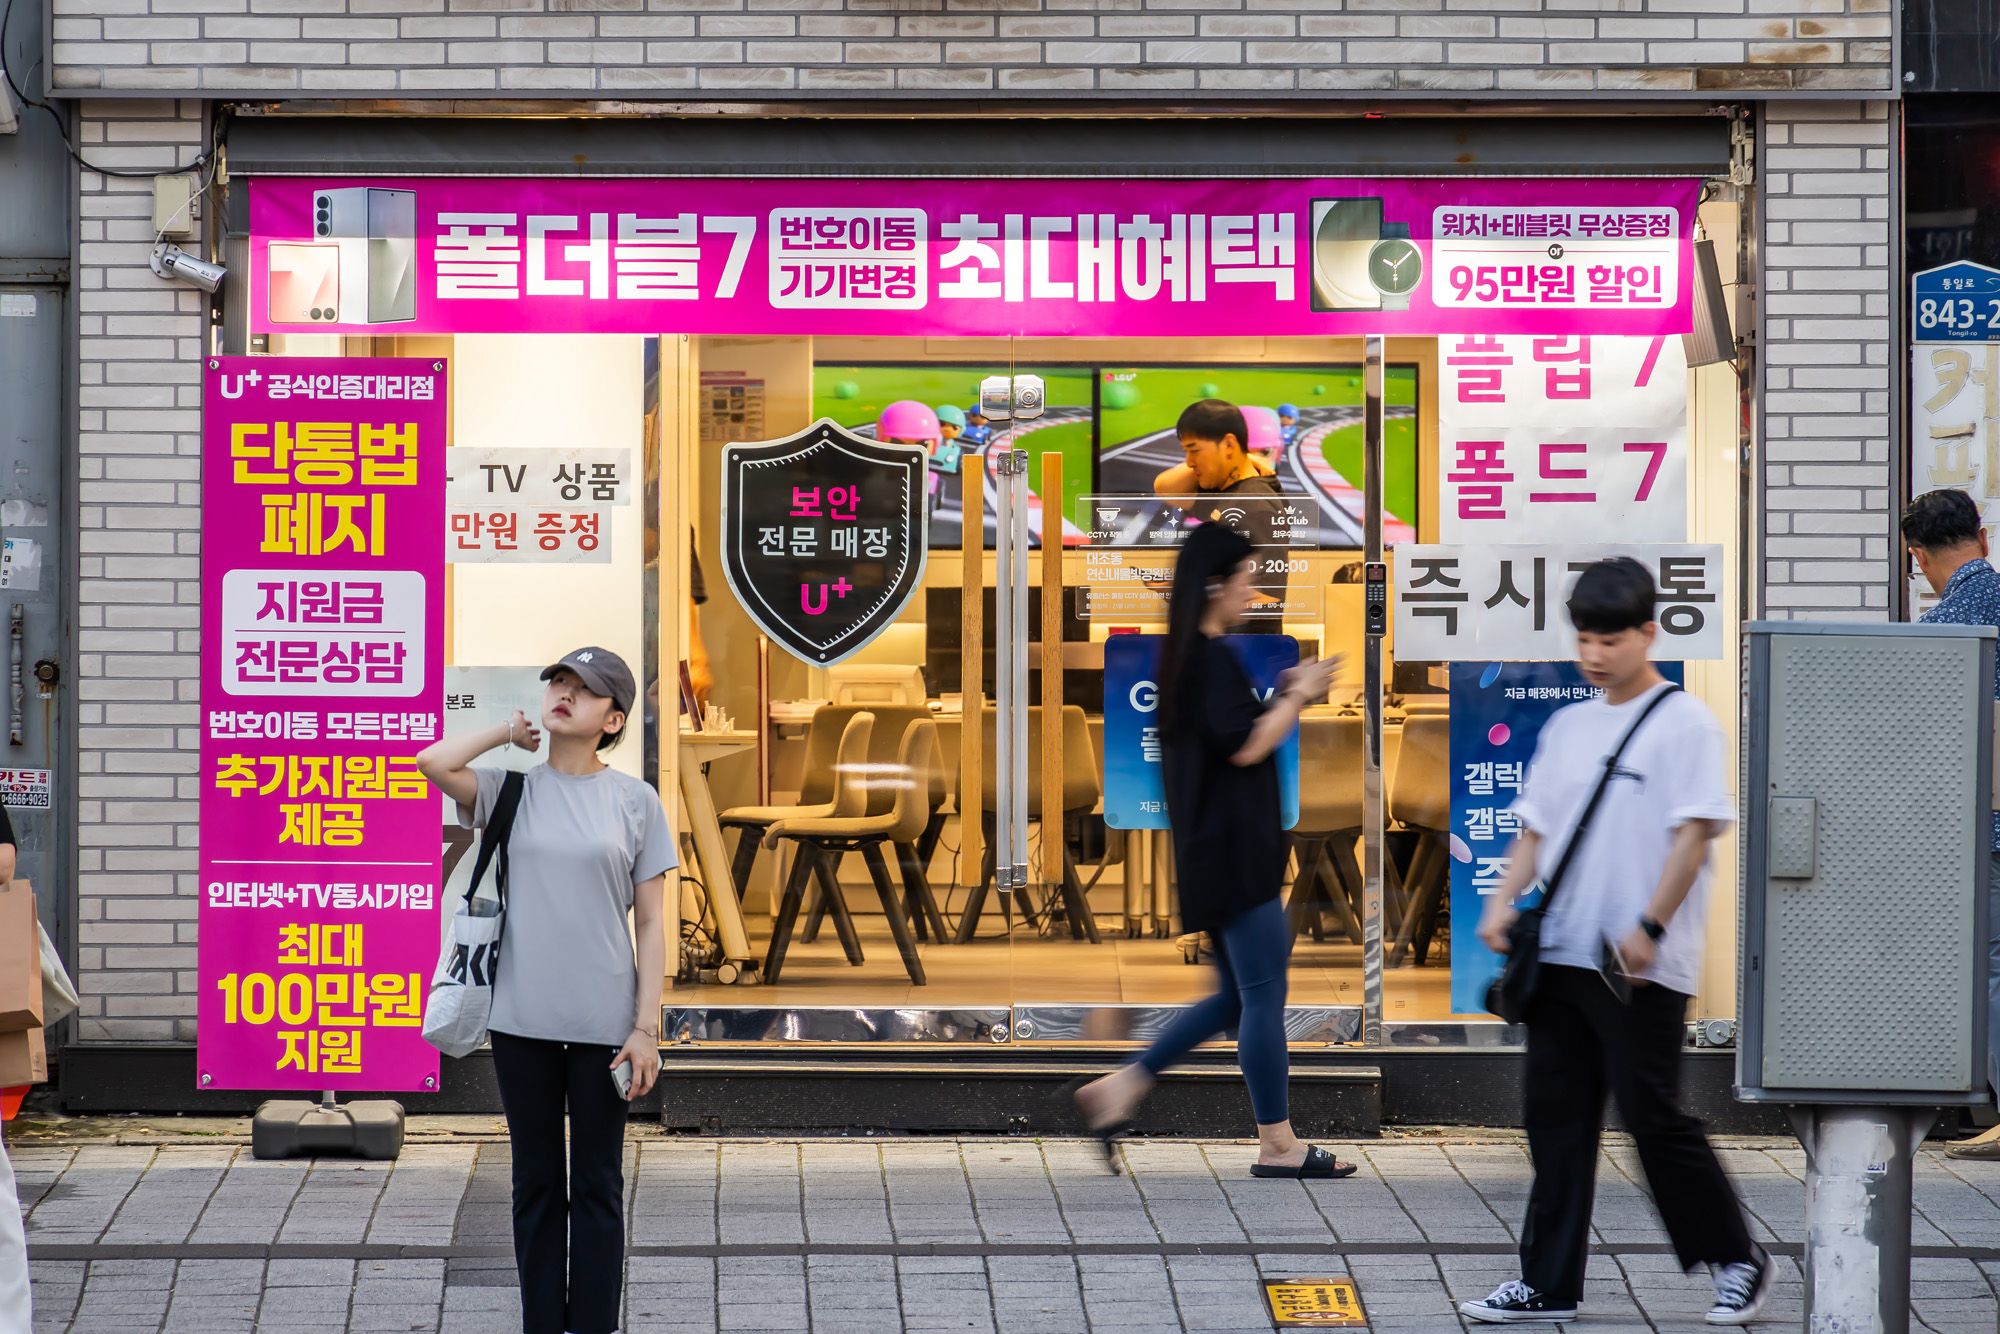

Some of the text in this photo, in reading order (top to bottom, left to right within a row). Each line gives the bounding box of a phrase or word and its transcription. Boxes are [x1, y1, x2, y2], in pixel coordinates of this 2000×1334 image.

[780, 216, 917, 252] 번호이동
[1441, 213, 1671, 238] 워치+태블릿 무상증정
[434, 212, 757, 300] 폴더블7
[938, 213, 1296, 302] 최대혜택
[1549, 246, 1562, 256] or
[780, 264, 917, 299] 기기변경
[1449, 264, 1662, 303] 95만원 할인
[1942, 278, 1975, 291] 통일로
[1947, 330, 1978, 338] Tongil-ro
[268, 374, 435, 400] 공식인증대리점
[231, 421, 418, 486] 단통법
[480, 463, 620, 501] TV 상품
[789, 485, 861, 521] 보안
[260, 492, 386, 556] 폐지
[451, 512, 600, 551] 만원 증정
[1271, 516, 1309, 526] LG Club
[757, 525, 891, 558] 전문 매장
[1086, 552, 1123, 566] 대조동
[1086, 567, 1175, 581] 연신내물빛공원점
[1265, 559, 1309, 573] 20:00
[256, 580, 384, 624] 지원금
[1401, 556, 1716, 636] 즉시통
[235, 640, 407, 684] 전문상담
[1504, 686, 1604, 699] 지금 매장에서 만나보
[209, 711, 437, 741] 번호이동 모든단말
[215, 753, 428, 800] 추가지원금
[1464, 761, 1536, 795] 갤럭
[1140, 800, 1161, 813] 지금
[1464, 807, 1528, 840] 갤럭
[278, 803, 365, 847] 제공
[208, 881, 433, 910] 인터넷+TV동시가입
[277, 922, 363, 967] 최대
[217, 972, 422, 1027] 100만원
[276, 1030, 362, 1074] 지원
